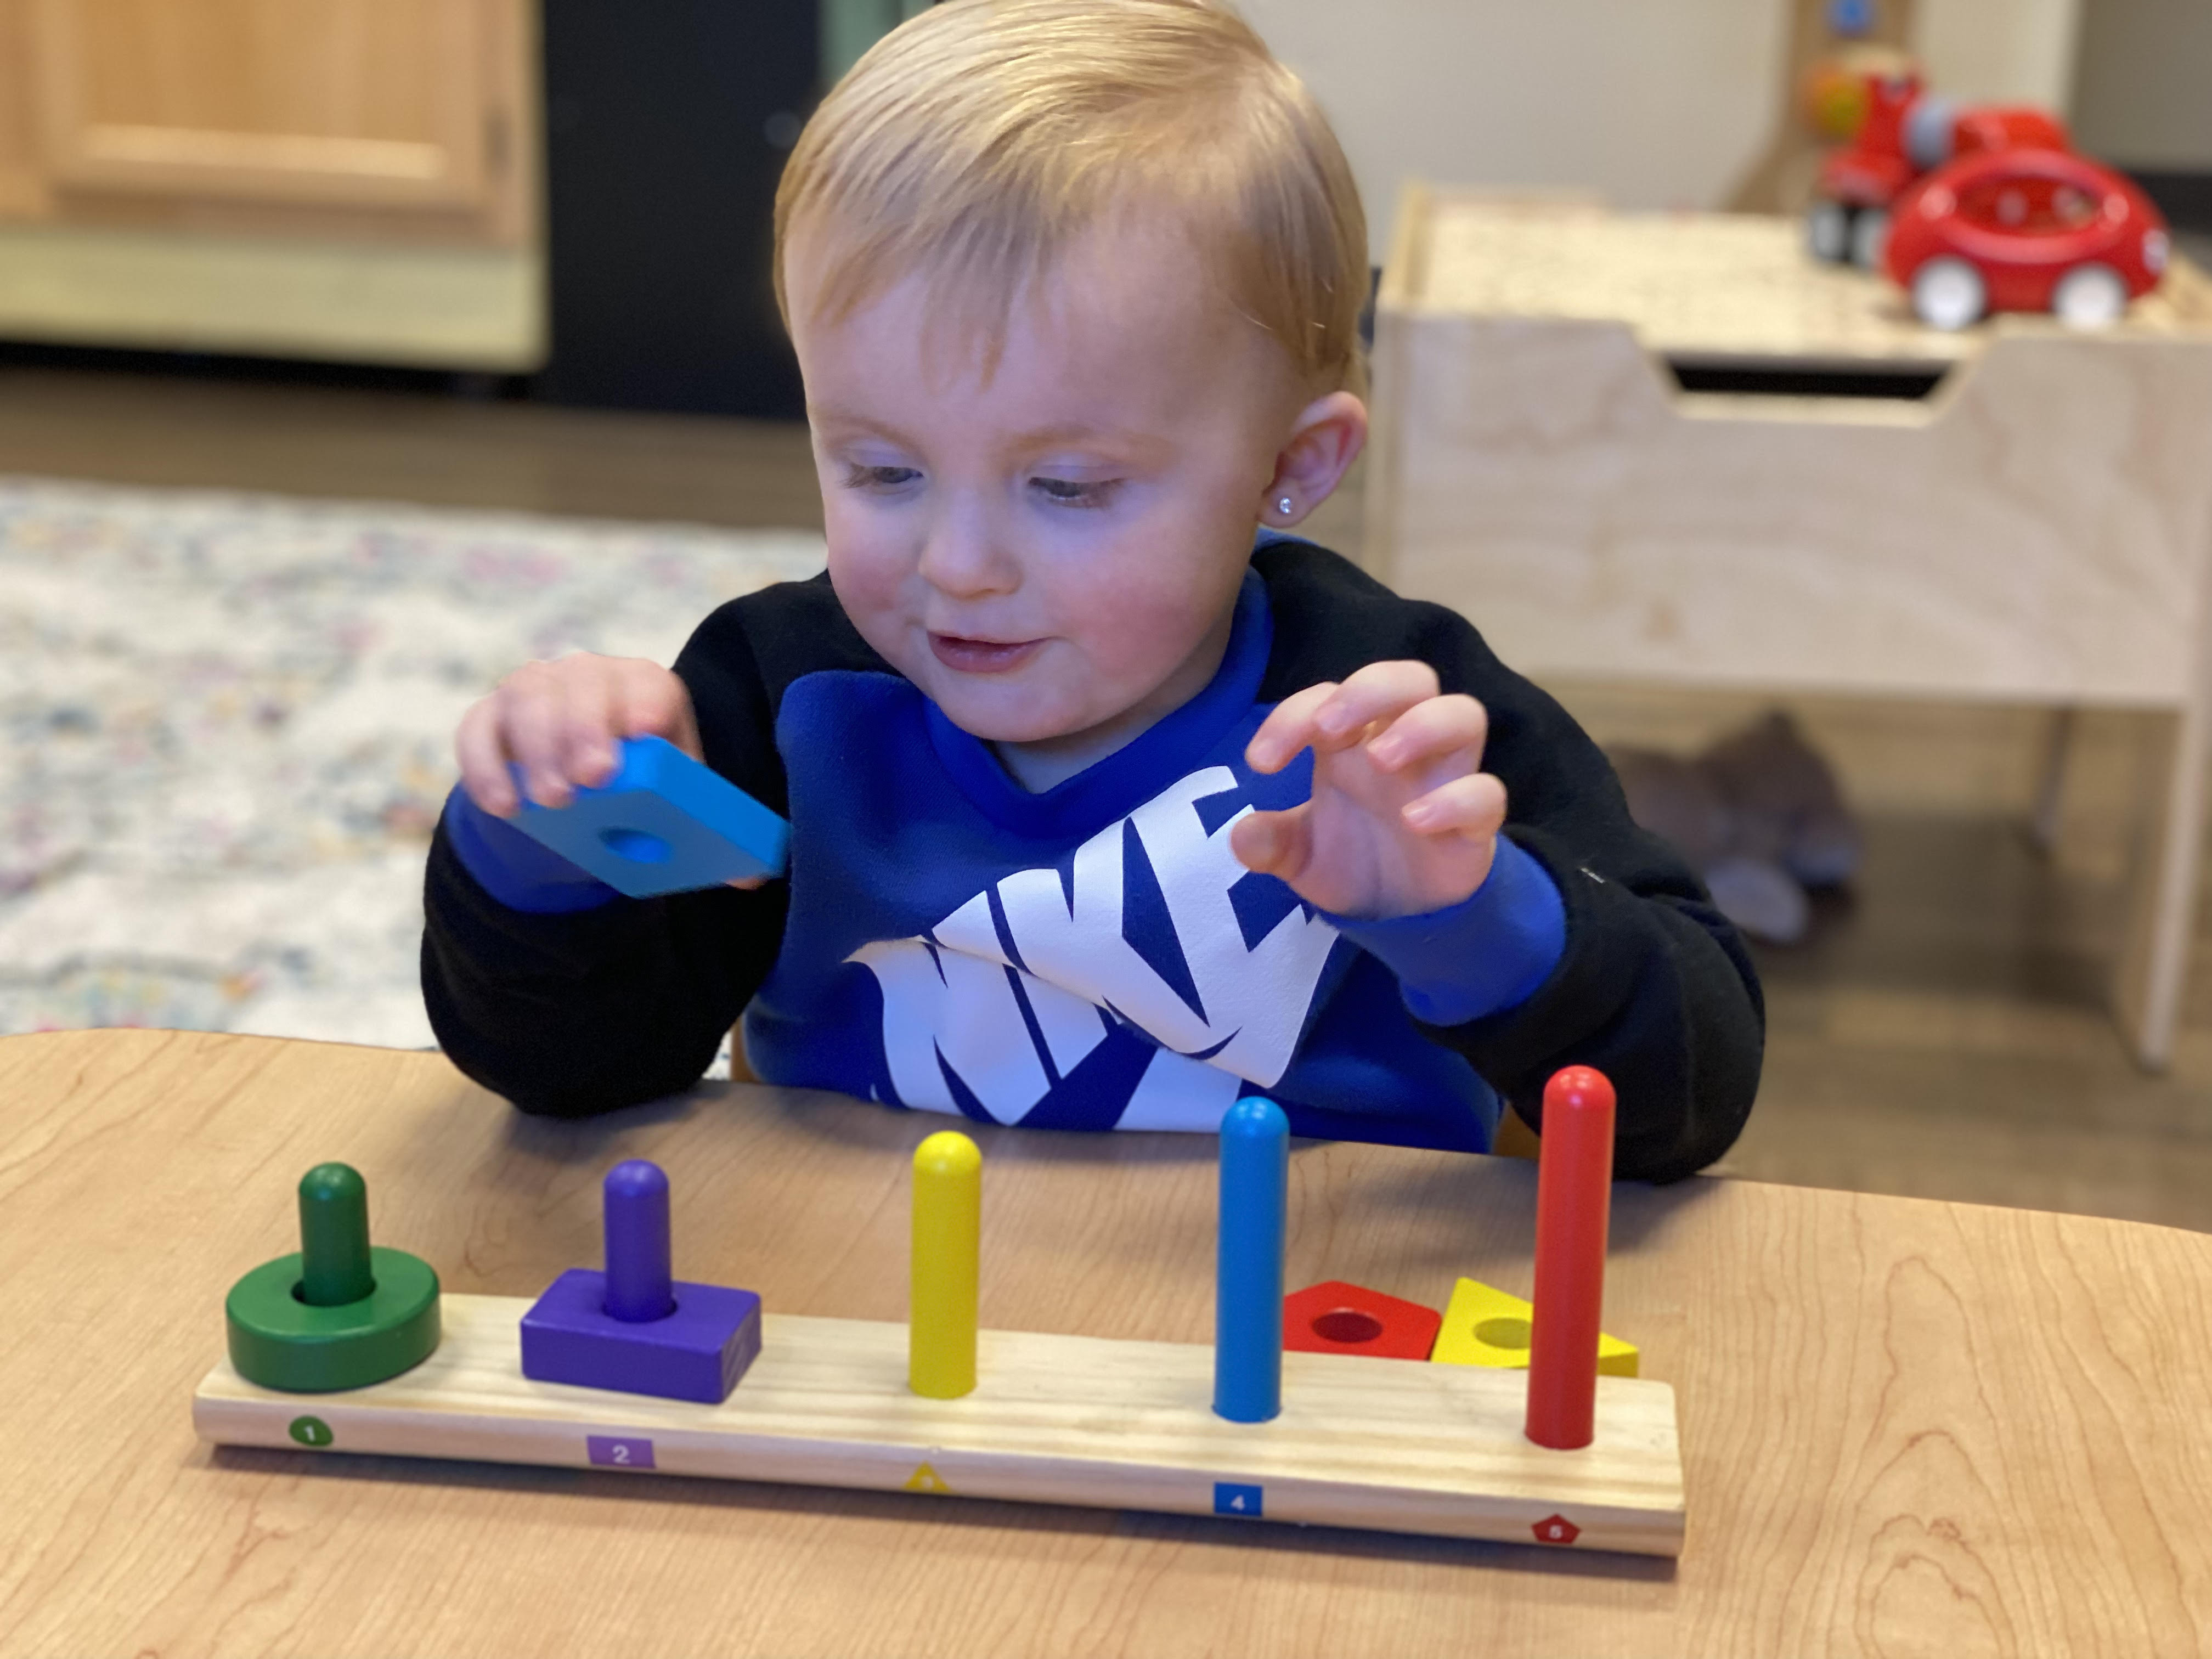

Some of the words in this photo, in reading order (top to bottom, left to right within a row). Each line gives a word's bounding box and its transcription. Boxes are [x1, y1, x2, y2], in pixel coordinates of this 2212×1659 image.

[304, 1426, 316, 1442] 1
[612, 1444, 630, 1464] 2
[1231, 1496, 1245, 1511] 4
[1549, 1525, 1562, 1539] 5
